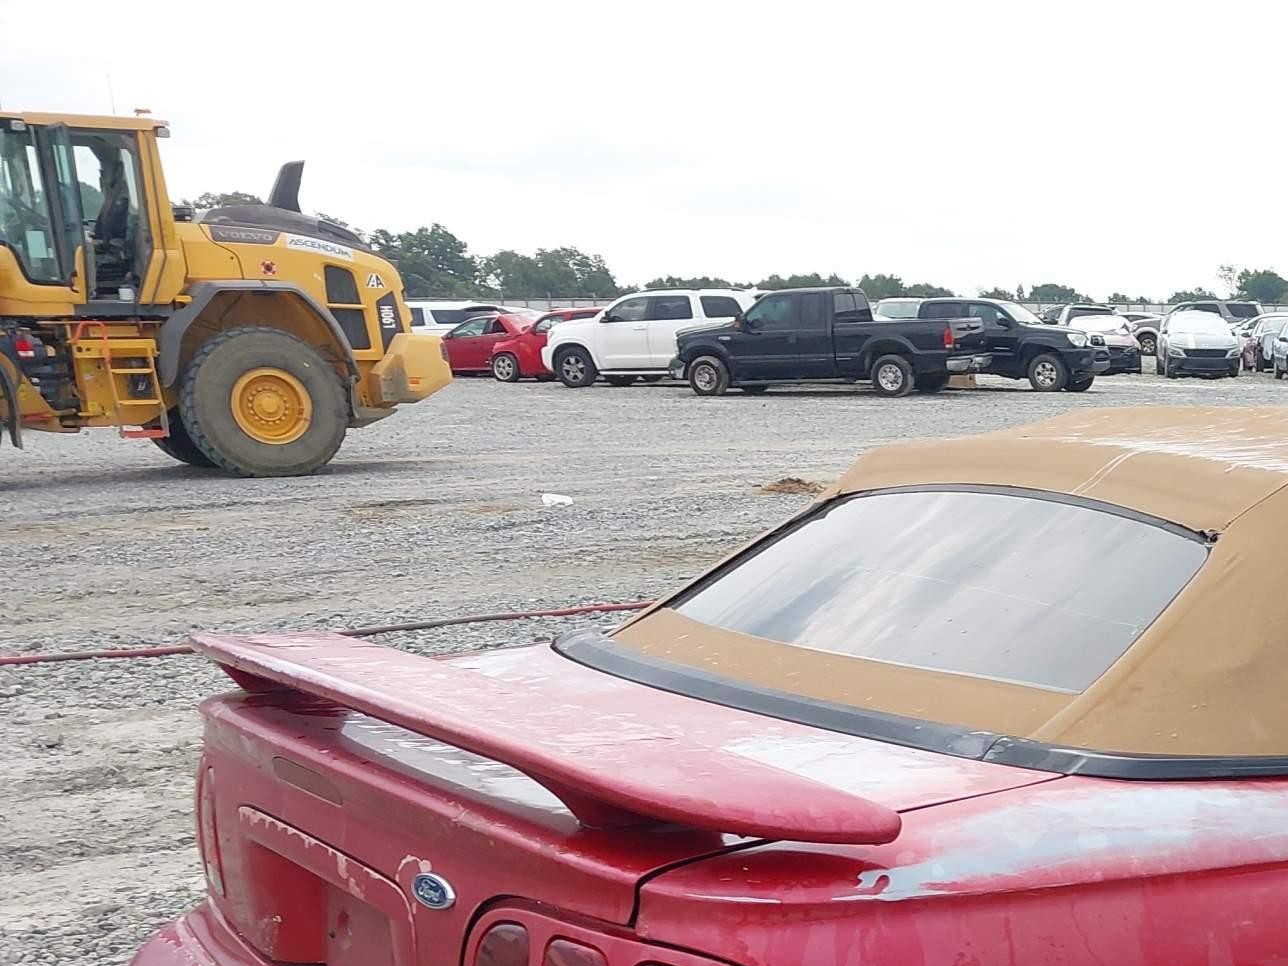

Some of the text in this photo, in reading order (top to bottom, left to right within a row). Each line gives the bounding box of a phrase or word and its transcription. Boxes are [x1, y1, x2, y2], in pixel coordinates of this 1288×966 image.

[216, 231, 273, 241] VOLVO
[289, 239, 352, 258] ASCENDUM
[380, 305, 396, 329] L90H
